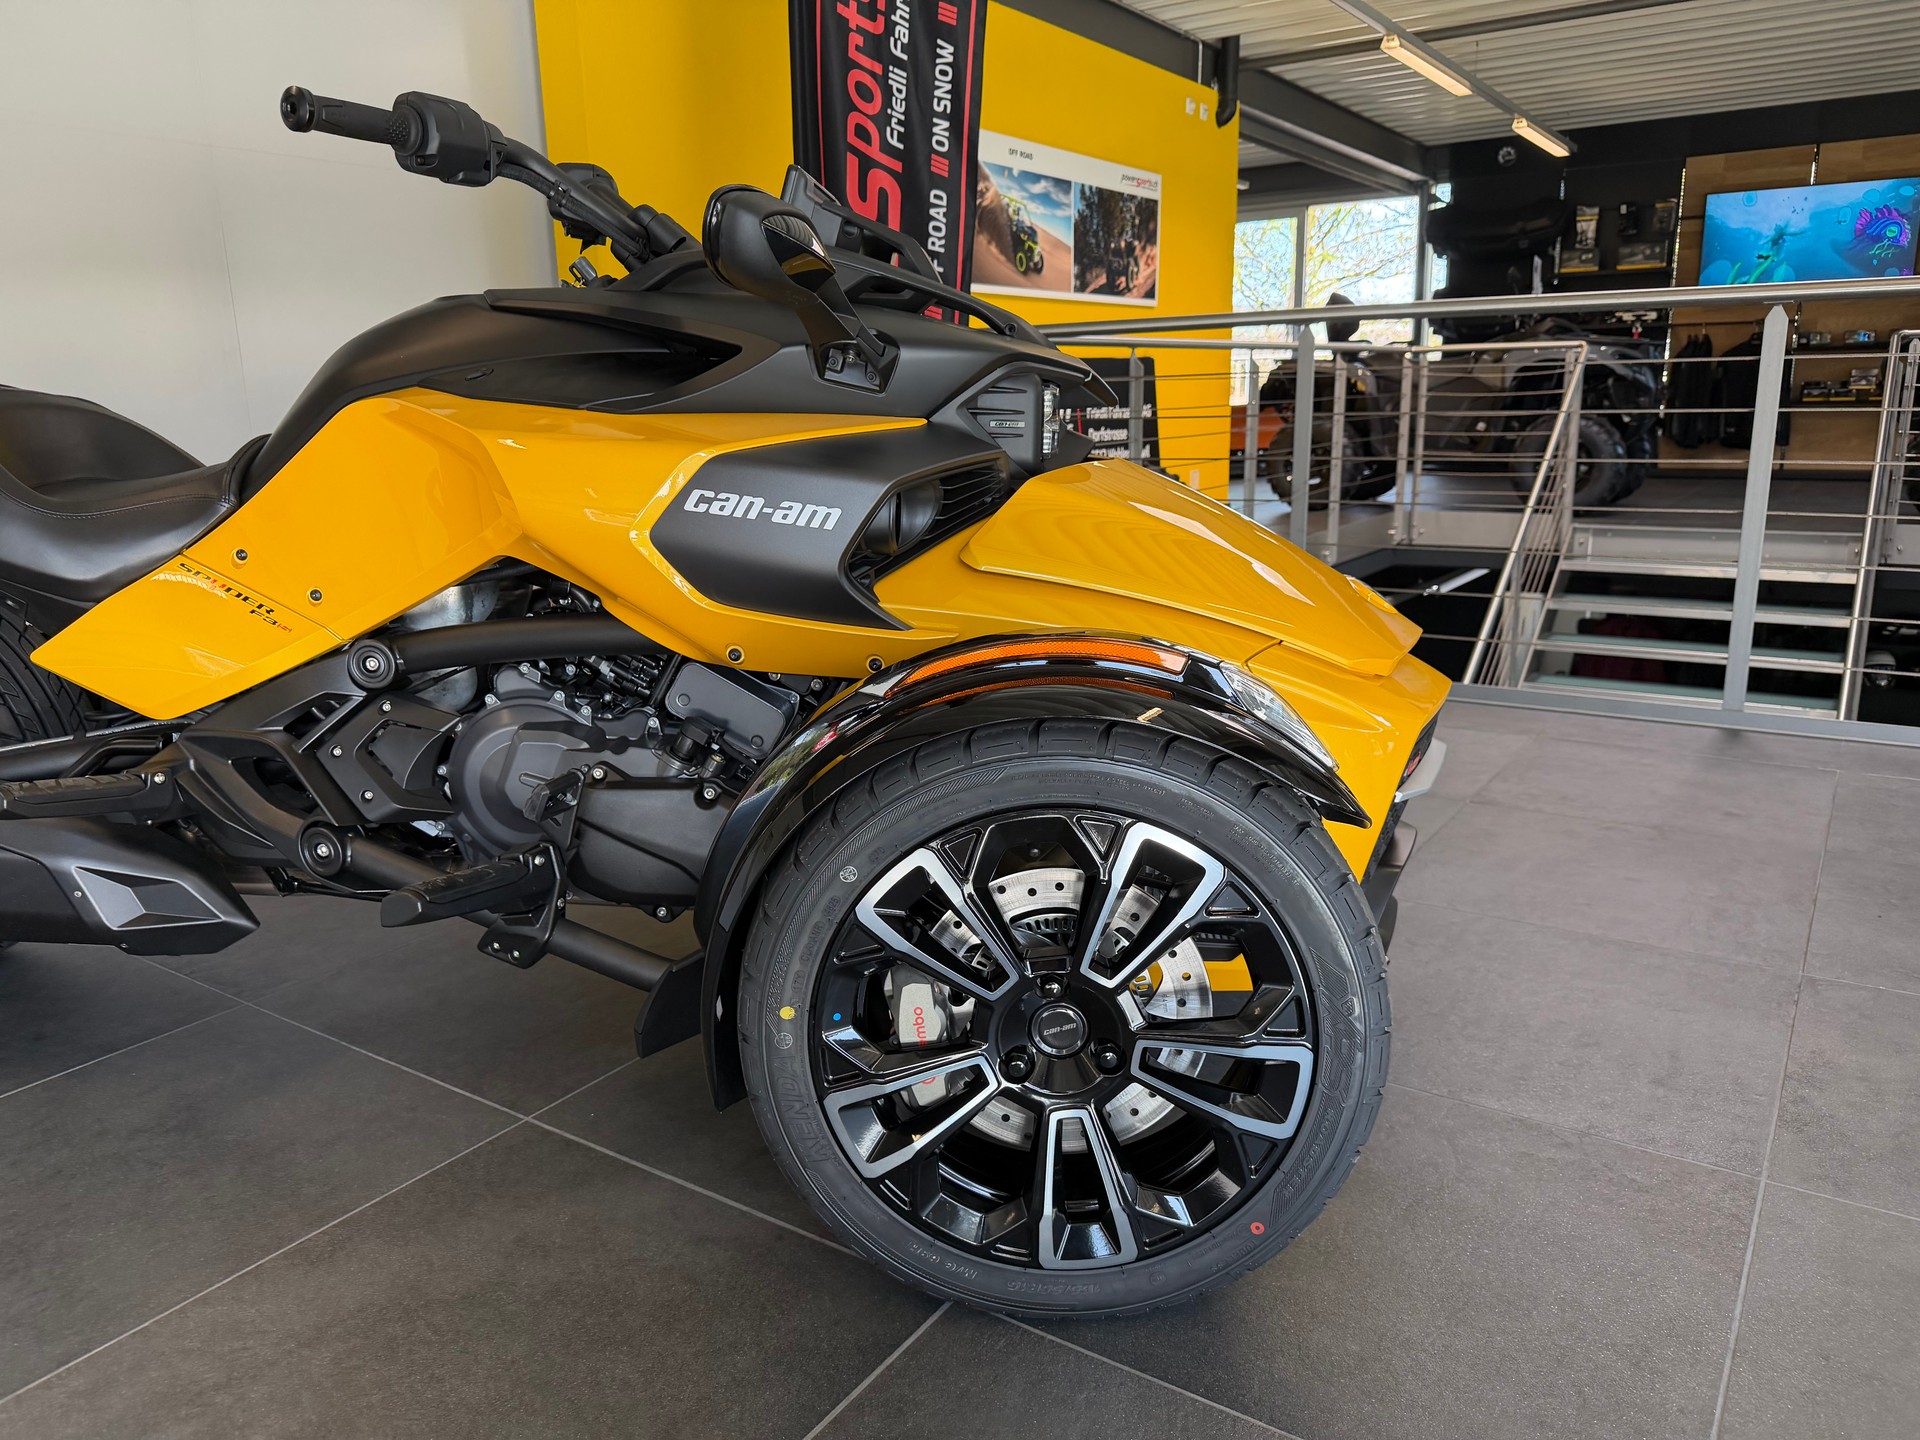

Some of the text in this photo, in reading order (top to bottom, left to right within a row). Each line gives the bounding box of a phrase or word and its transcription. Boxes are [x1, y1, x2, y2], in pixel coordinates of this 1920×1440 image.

[837, 0, 903, 233] Sport
[886, 0, 911, 150] Friedli Fahr
[931, 38, 955, 153] ON SNOW
[927, 188, 948, 254] ROAD
[683, 488, 842, 531] can-am
[1043, 1022, 1077, 1036] can-am
